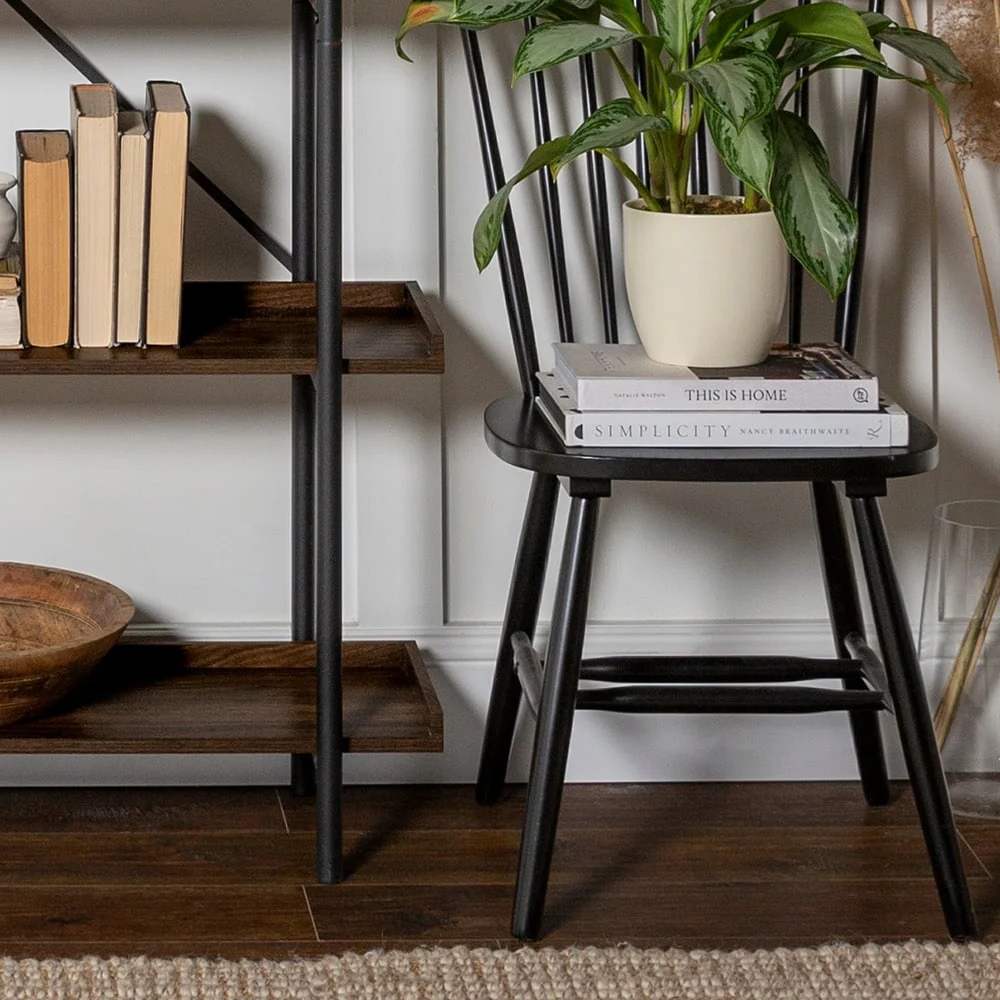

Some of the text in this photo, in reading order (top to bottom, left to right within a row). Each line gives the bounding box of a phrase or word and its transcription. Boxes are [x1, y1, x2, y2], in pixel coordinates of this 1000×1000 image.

[685, 389, 787, 401] THIS IS HOME
[595, 425, 730, 438] SIMPLICITY
[740, 427, 850, 435] NANCY BRAITHWAITE
